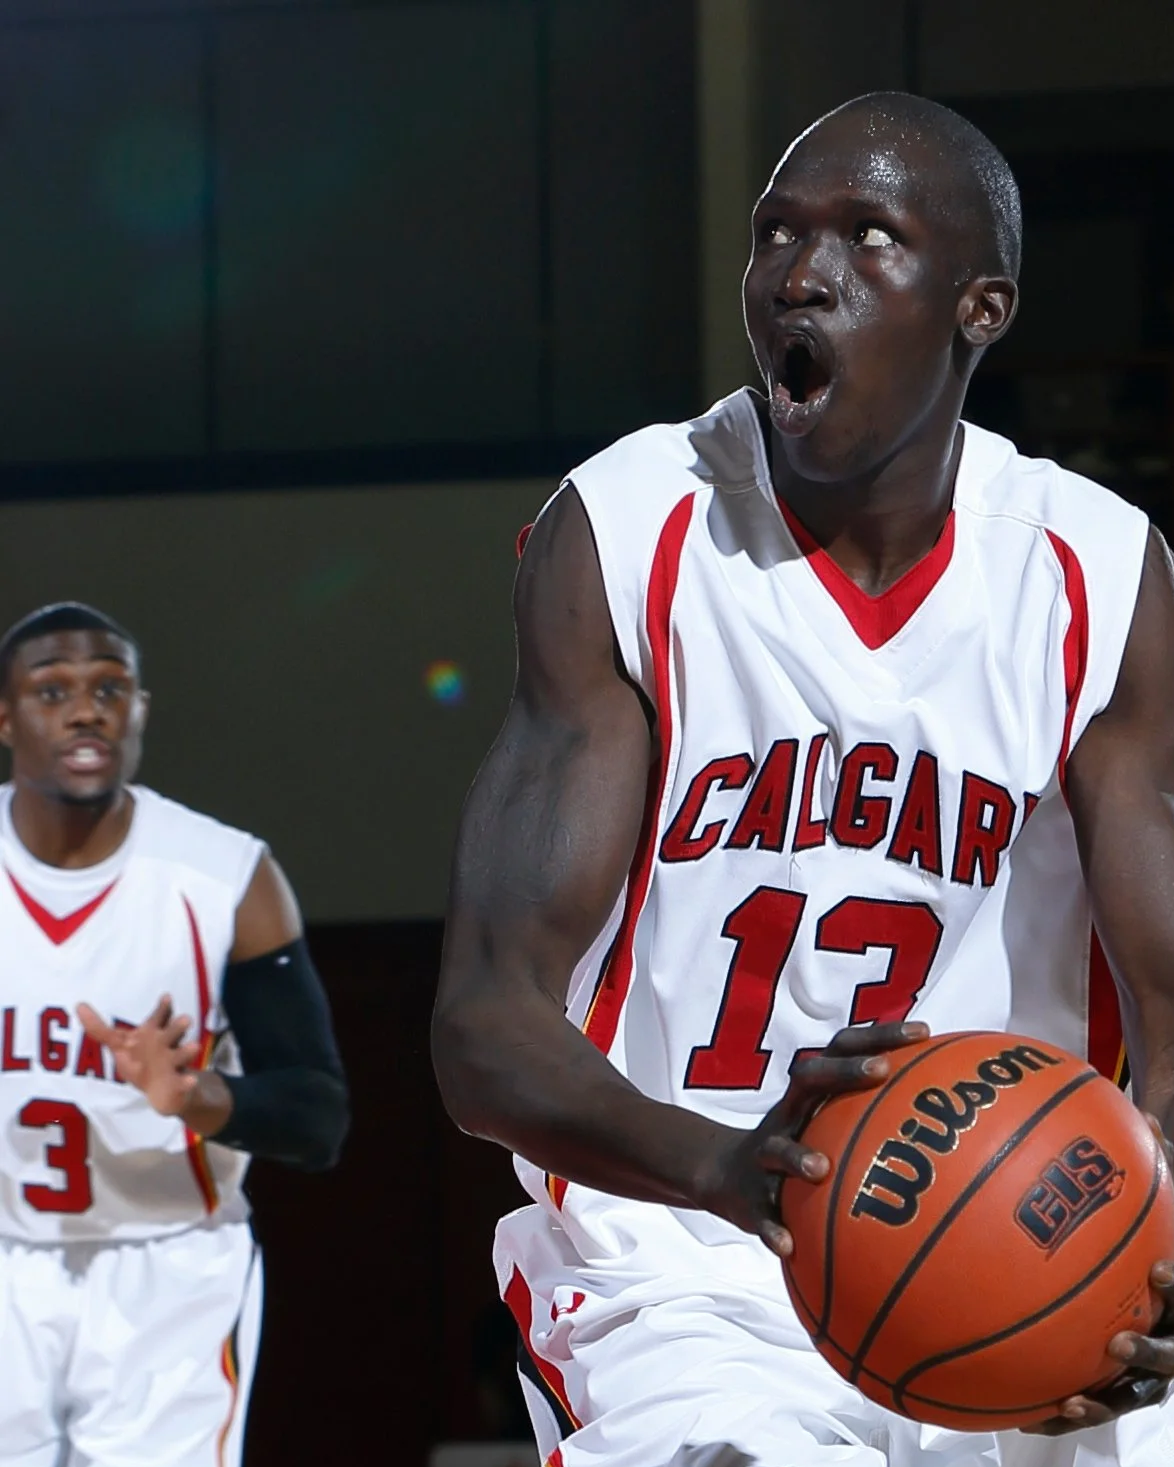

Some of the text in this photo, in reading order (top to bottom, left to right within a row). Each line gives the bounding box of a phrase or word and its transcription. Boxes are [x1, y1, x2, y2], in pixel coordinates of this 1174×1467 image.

[659, 733, 1042, 888] CALGAR
[18, 1097, 94, 1213] 3
[850, 1042, 1064, 1228] Wilson
[1012, 1135, 1120, 1250] CIS
